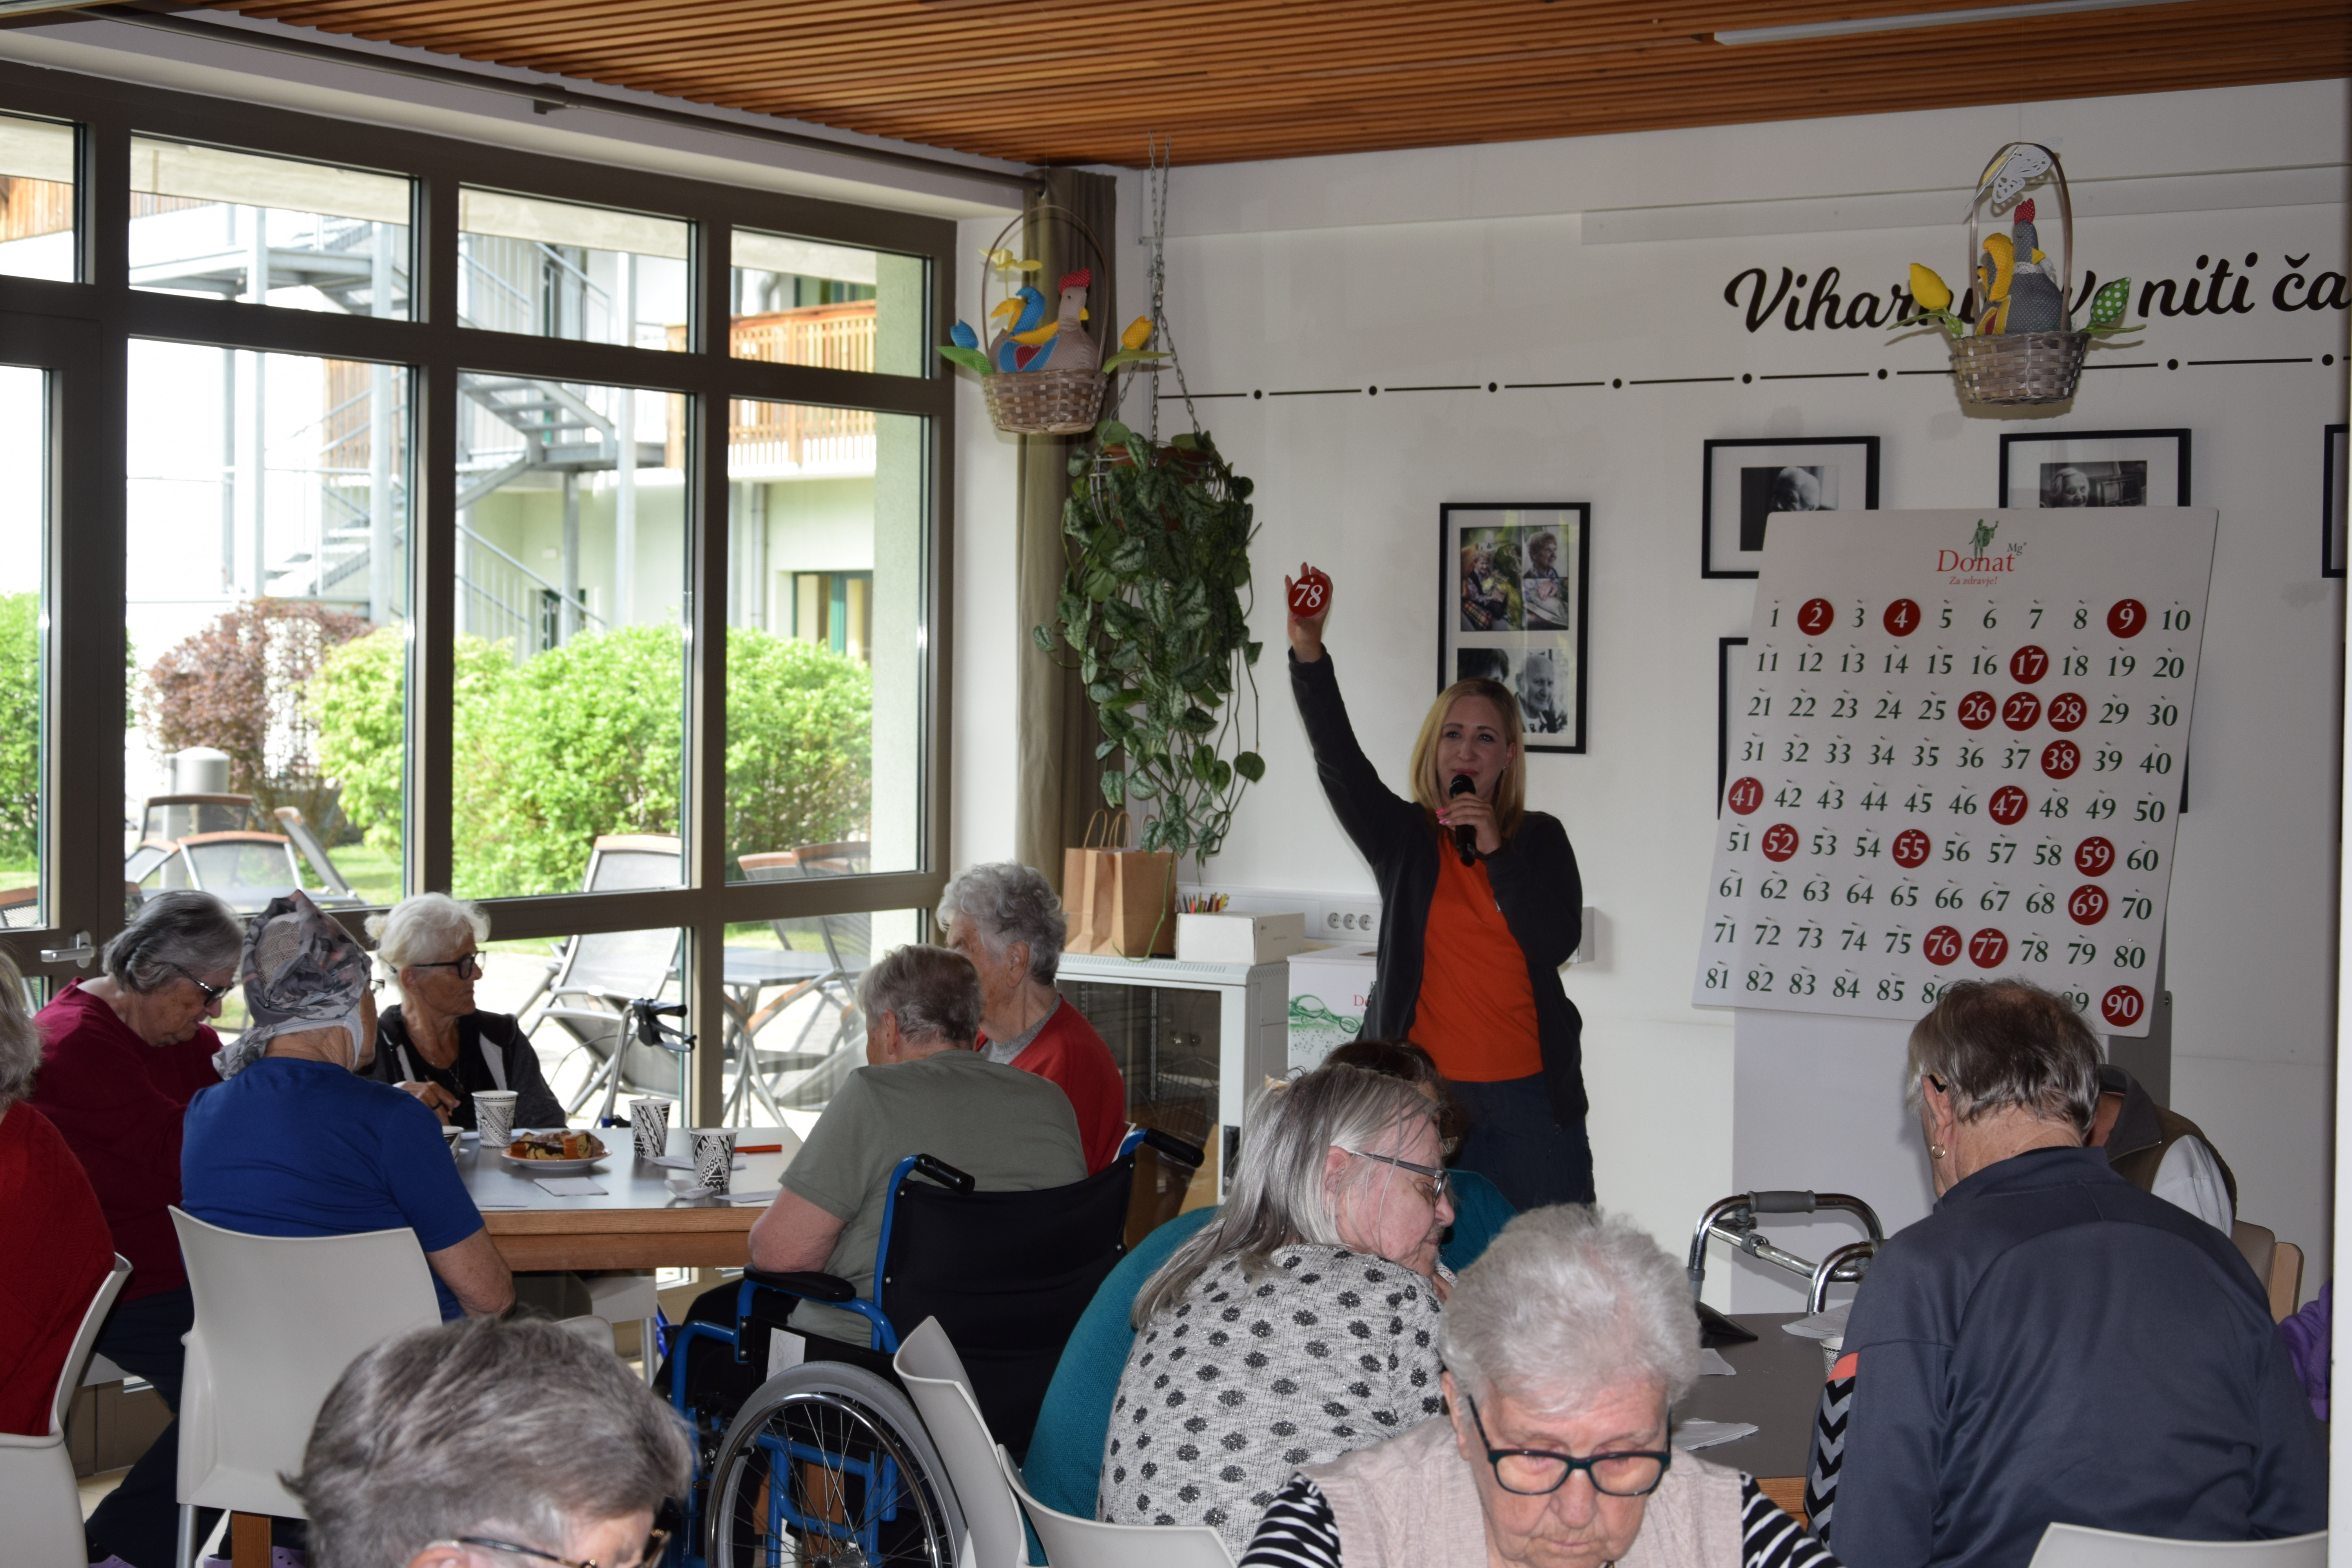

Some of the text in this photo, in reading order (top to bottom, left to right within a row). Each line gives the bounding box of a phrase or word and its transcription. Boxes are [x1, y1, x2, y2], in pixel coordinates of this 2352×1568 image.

[2138, 252, 2258, 318] niti
[1936, 550, 2016, 572] Donat
[1294, 584, 1323, 607] 78
[1949, 576, 1998, 587] Za zdravje!
[1771, 607, 2190, 631] 1 2 3 4 5 6 7 8 9 10
[1758, 652, 2184, 678] 11 12 13 14 15 16 17 18 19 20
[1748, 697, 2178, 726] 21 22 23 24 25 26 27 28 29 30
[1742, 741, 2171, 774] 31 32 33 34 35 36 37 38 39 40
[1732, 786, 2165, 822] 41 42 43 44 45 46 47 48 49 50
[1727, 832, 2158, 871] 51 52 53 54 55 56 57 58 59 60
[1720, 877, 2152, 920] 61 62 63 64 65 66 67 68 69 70
[1715, 923, 2145, 969] 71 72 73 74 75 76 77 78 79 80
[1706, 968, 1728, 989] 81
[1746, 971, 1773, 992] 82
[1789, 974, 1815, 995] 83
[1833, 976, 1860, 998] 84
[1877, 980, 1904, 1001] 85
[2107, 995, 2138, 1017] 90
